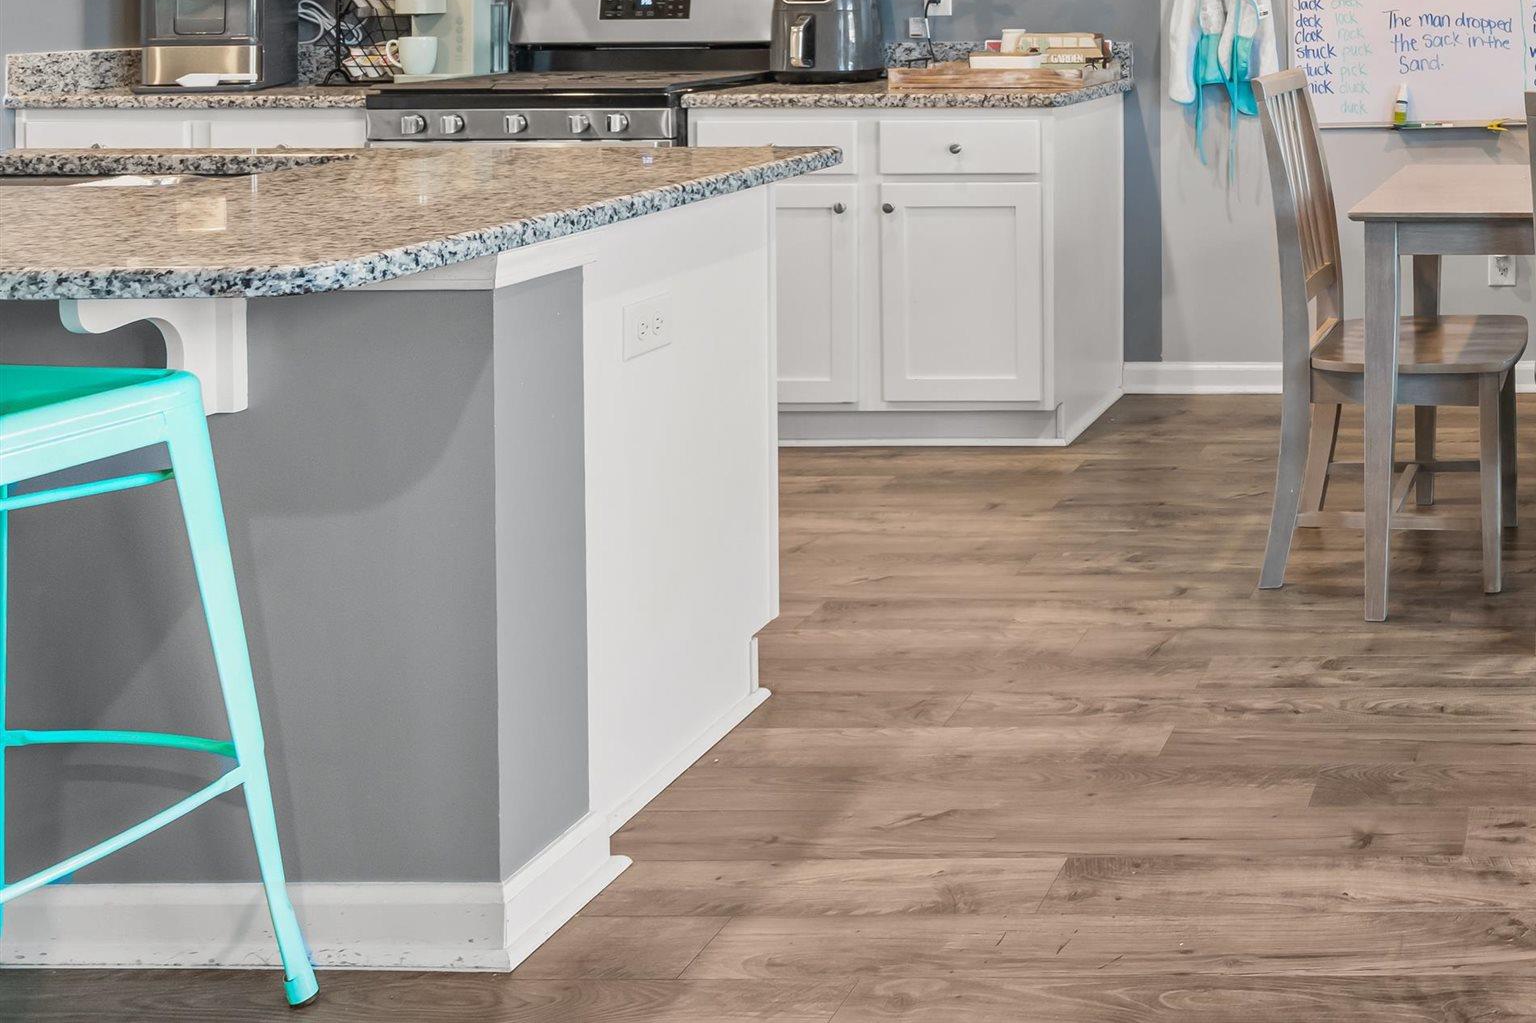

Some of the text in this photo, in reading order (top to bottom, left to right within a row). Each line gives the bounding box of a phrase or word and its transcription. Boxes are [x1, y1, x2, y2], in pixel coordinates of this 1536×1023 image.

[1295, 13, 1323, 29] deck
[1382, 9, 1513, 35] The man dropped
[1390, 33, 1419, 53] the
[1466, 32, 1484, 48] in
[1484, 34, 1511, 50] the
[1296, 43, 1337, 59] struck
[1296, 61, 1333, 77] tuck
